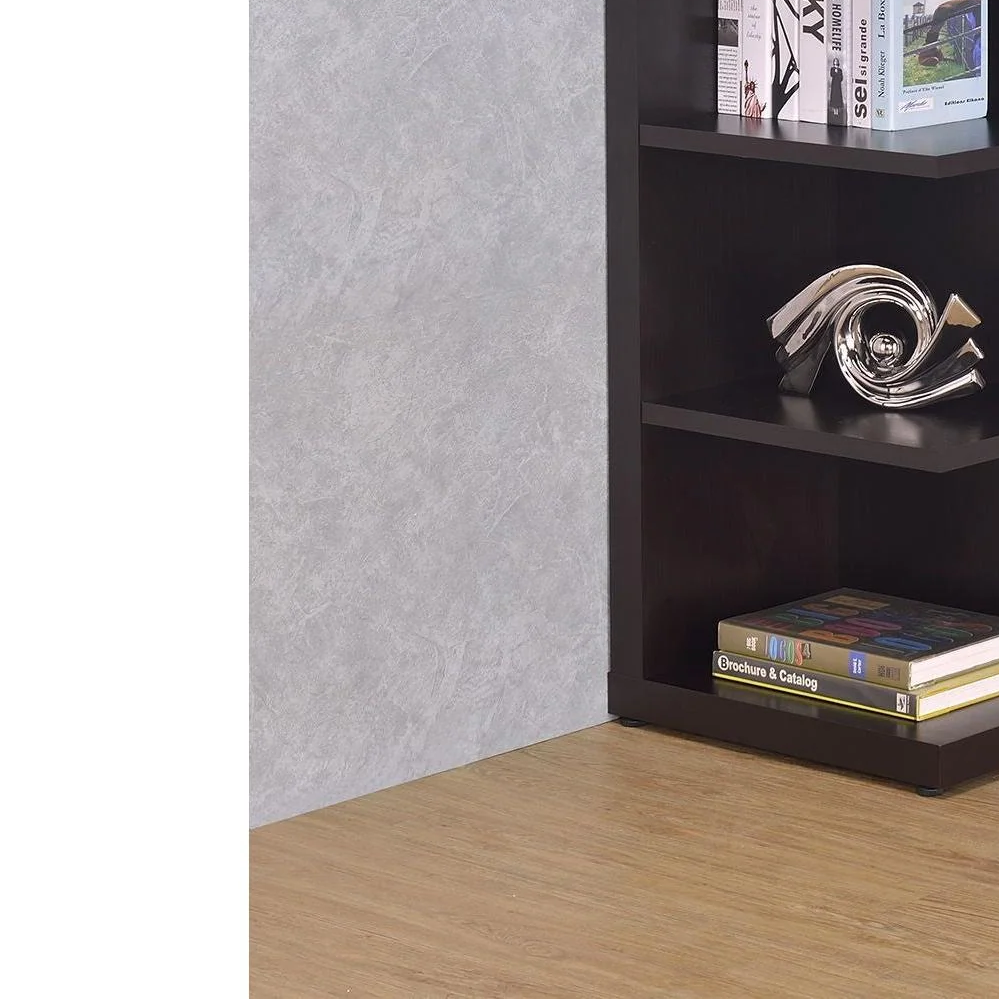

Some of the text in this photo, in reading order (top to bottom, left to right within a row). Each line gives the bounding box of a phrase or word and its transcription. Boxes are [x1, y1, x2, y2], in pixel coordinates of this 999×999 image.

[832, 3, 842, 52] HOMELIFE
[859, 18, 868, 63] grande
[878, 24, 886, 39] La
[878, 50, 887, 74] Klieger
[717, 654, 818, 691] Brochure & Catalog
